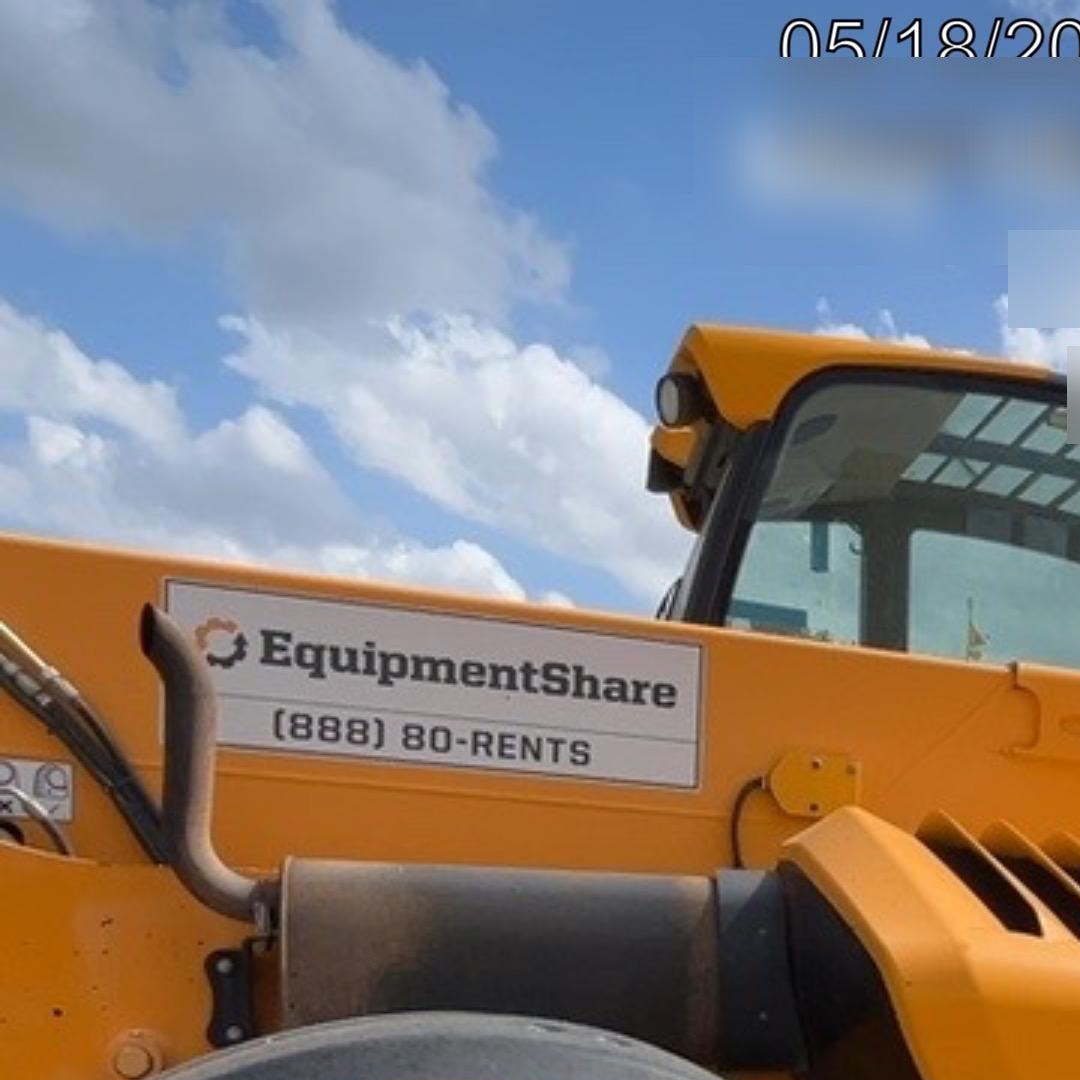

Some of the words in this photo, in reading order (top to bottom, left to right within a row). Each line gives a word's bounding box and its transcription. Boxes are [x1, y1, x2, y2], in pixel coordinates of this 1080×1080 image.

[260, 628, 677, 709] EquipmentShare
[272, 708, 386, 751] (888)
[402, 724, 592, 768] 80-RENTS
